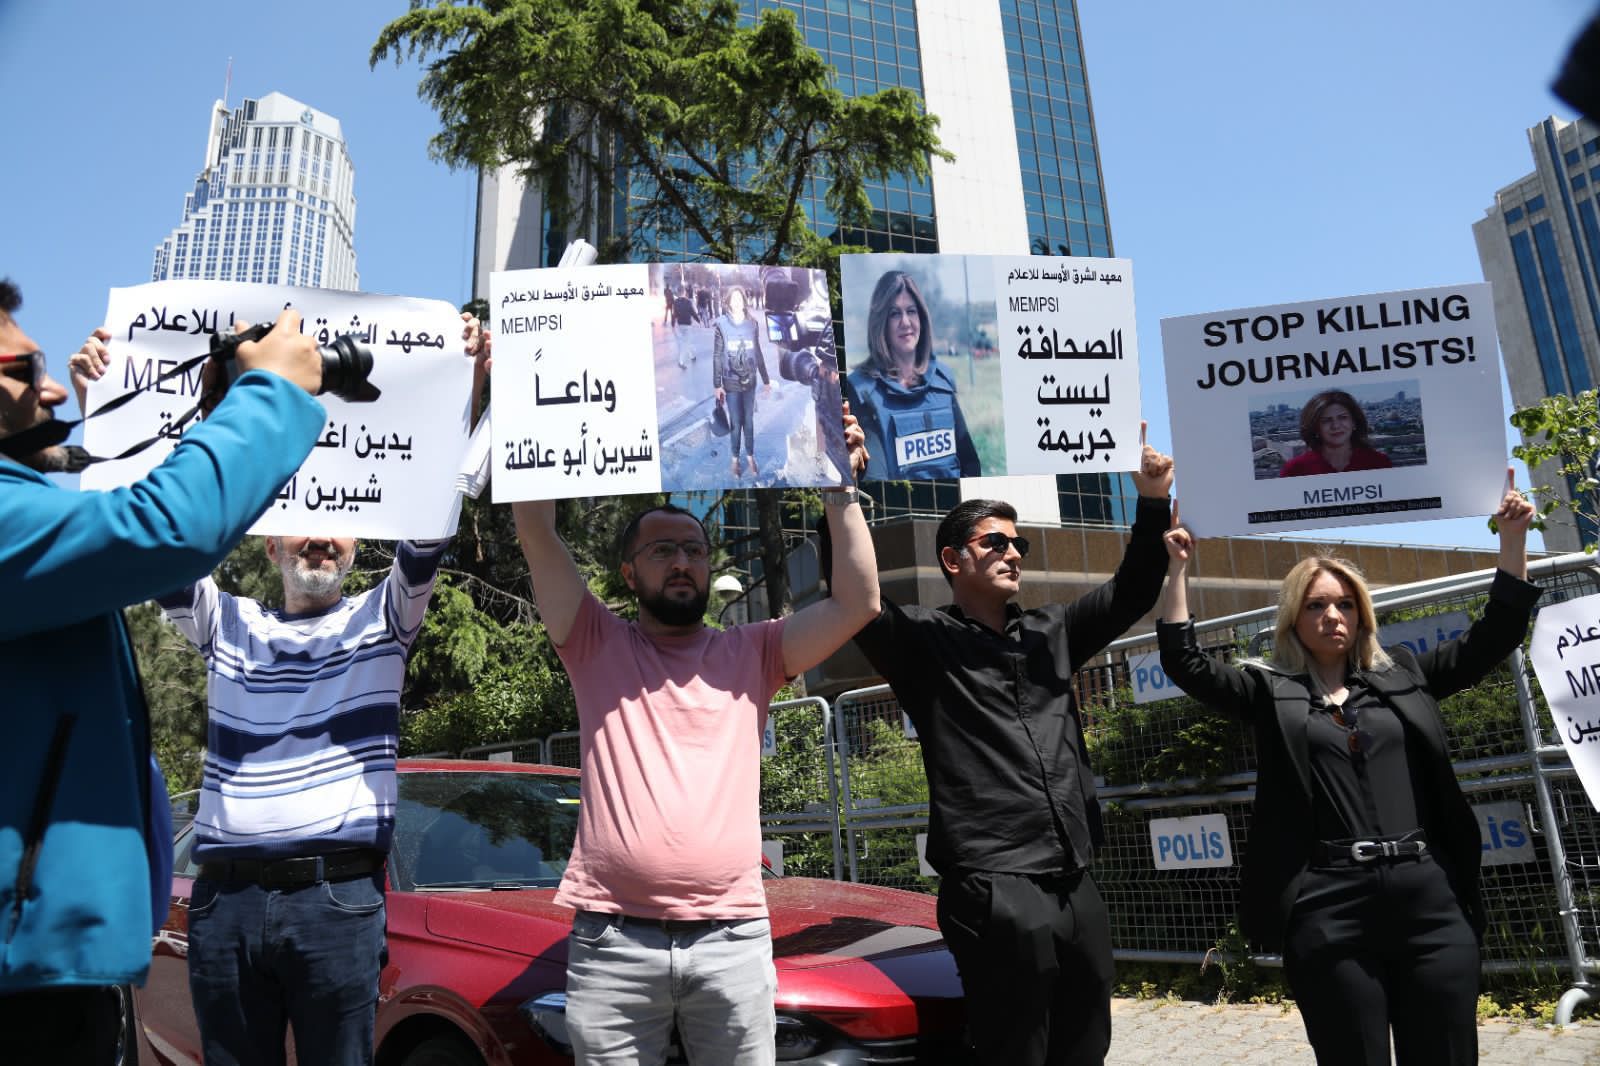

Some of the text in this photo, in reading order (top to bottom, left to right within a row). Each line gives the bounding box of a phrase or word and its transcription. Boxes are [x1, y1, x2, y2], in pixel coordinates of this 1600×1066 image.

[1042, 263, 1070, 284] الأوسط
[1072, 266, 1097, 284] الشرق
[1099, 273, 1122, 285] معهد
[543, 281, 578, 302] الأوسط
[581, 282, 612, 300] الشرق
[616, 286, 645, 299] معهد
[1008, 296, 1059, 313] MEMPSI
[501, 313, 562, 335] MEMPSI
[1203, 294, 1471, 347] STOP KILLING
[386, 328, 445, 353] معهد
[1016, 325, 1124, 360] الصحافة
[124, 355, 206, 398] MEM
[1196, 336, 1477, 390] JOURNALISTS!
[1037, 374, 1111, 417] ليست
[355, 424, 413, 461] يدين
[593, 429, 653, 475] شيرين
[904, 432, 952, 461] PRESS
[1036, 417, 1116, 464] جريمة
[305, 473, 382, 512] شيرين
[1303, 484, 1384, 504] MEMPSI
